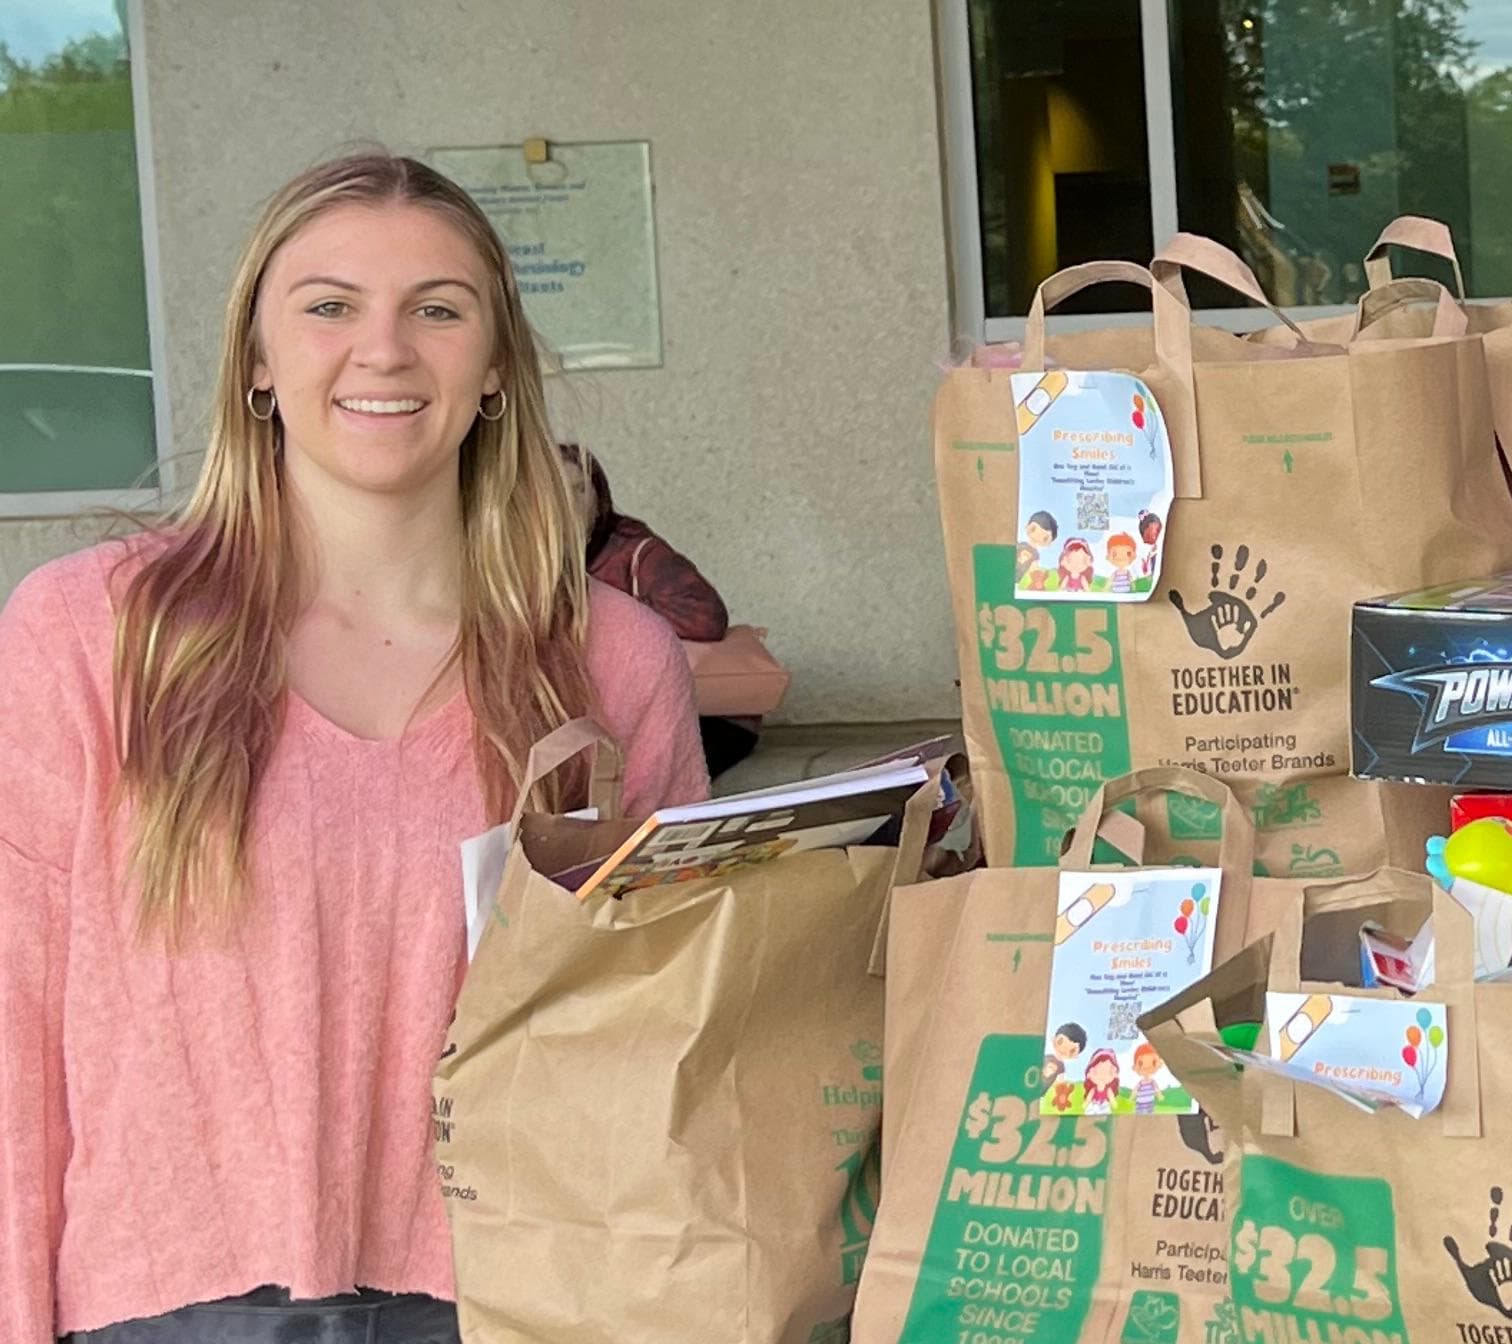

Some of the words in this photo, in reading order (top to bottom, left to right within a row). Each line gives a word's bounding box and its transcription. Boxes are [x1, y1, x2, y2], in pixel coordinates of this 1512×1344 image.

[978, 604, 1114, 675] $32.5
[1171, 665, 1265, 690] TOGETHER
[1272, 663, 1291, 685] IN
[986, 677, 1121, 718] MILLION
[1010, 726, 1104, 754] DONATED
[1185, 733, 1297, 753] Participating
[1272, 752, 1336, 771] Brands
[1313, 1060, 1403, 1086] Prescribing
[947, 1167, 1106, 1215] MILLION
[1156, 1167, 1224, 1194] TOGETH
[1151, 1193, 1226, 1222] EDUCA
[1288, 1196, 1344, 1229] OVER
[963, 1221, 1080, 1253] DONATED
[954, 1247, 989, 1272] TO
[999, 1249, 1076, 1283] LOCAL
[1130, 1262, 1171, 1280] Harris
[1233, 1219, 1393, 1322] $32.5
[947, 1276, 1073, 1310] SCHOOLS
[958, 1303, 1040, 1334] SINCE
